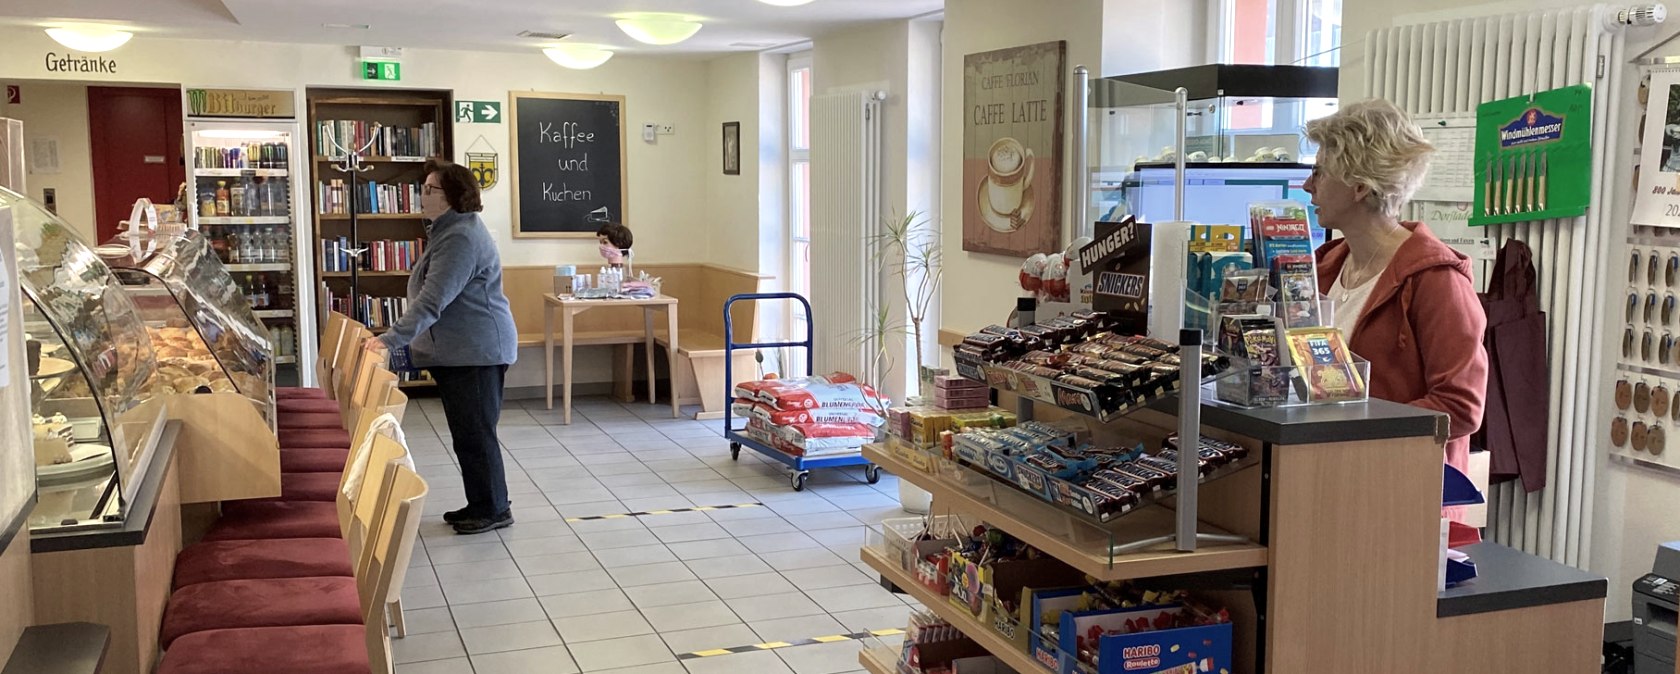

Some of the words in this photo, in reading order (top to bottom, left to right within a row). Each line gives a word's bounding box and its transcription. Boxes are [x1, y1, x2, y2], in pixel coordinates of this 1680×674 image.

[45, 52, 117, 73] Getränke
[974, 104, 1005, 125] CAFFE
[1012, 100, 1047, 123] LATTE
[539, 121, 595, 149] Kaffee
[1500, 122, 1562, 141] Windmühlenmesser
[558, 152, 588, 172] und
[542, 181, 592, 202] Kuchen
[1665, 203, 1680, 217] 20
[1081, 221, 1135, 269] HUNGER?
[1099, 273, 1144, 297] SNICKERS
[1310, 339, 1329, 347] FIFA
[1313, 347, 1331, 356] 365
[1123, 644, 1161, 659] HARIBO
[1125, 658, 1160, 670] Roulette
